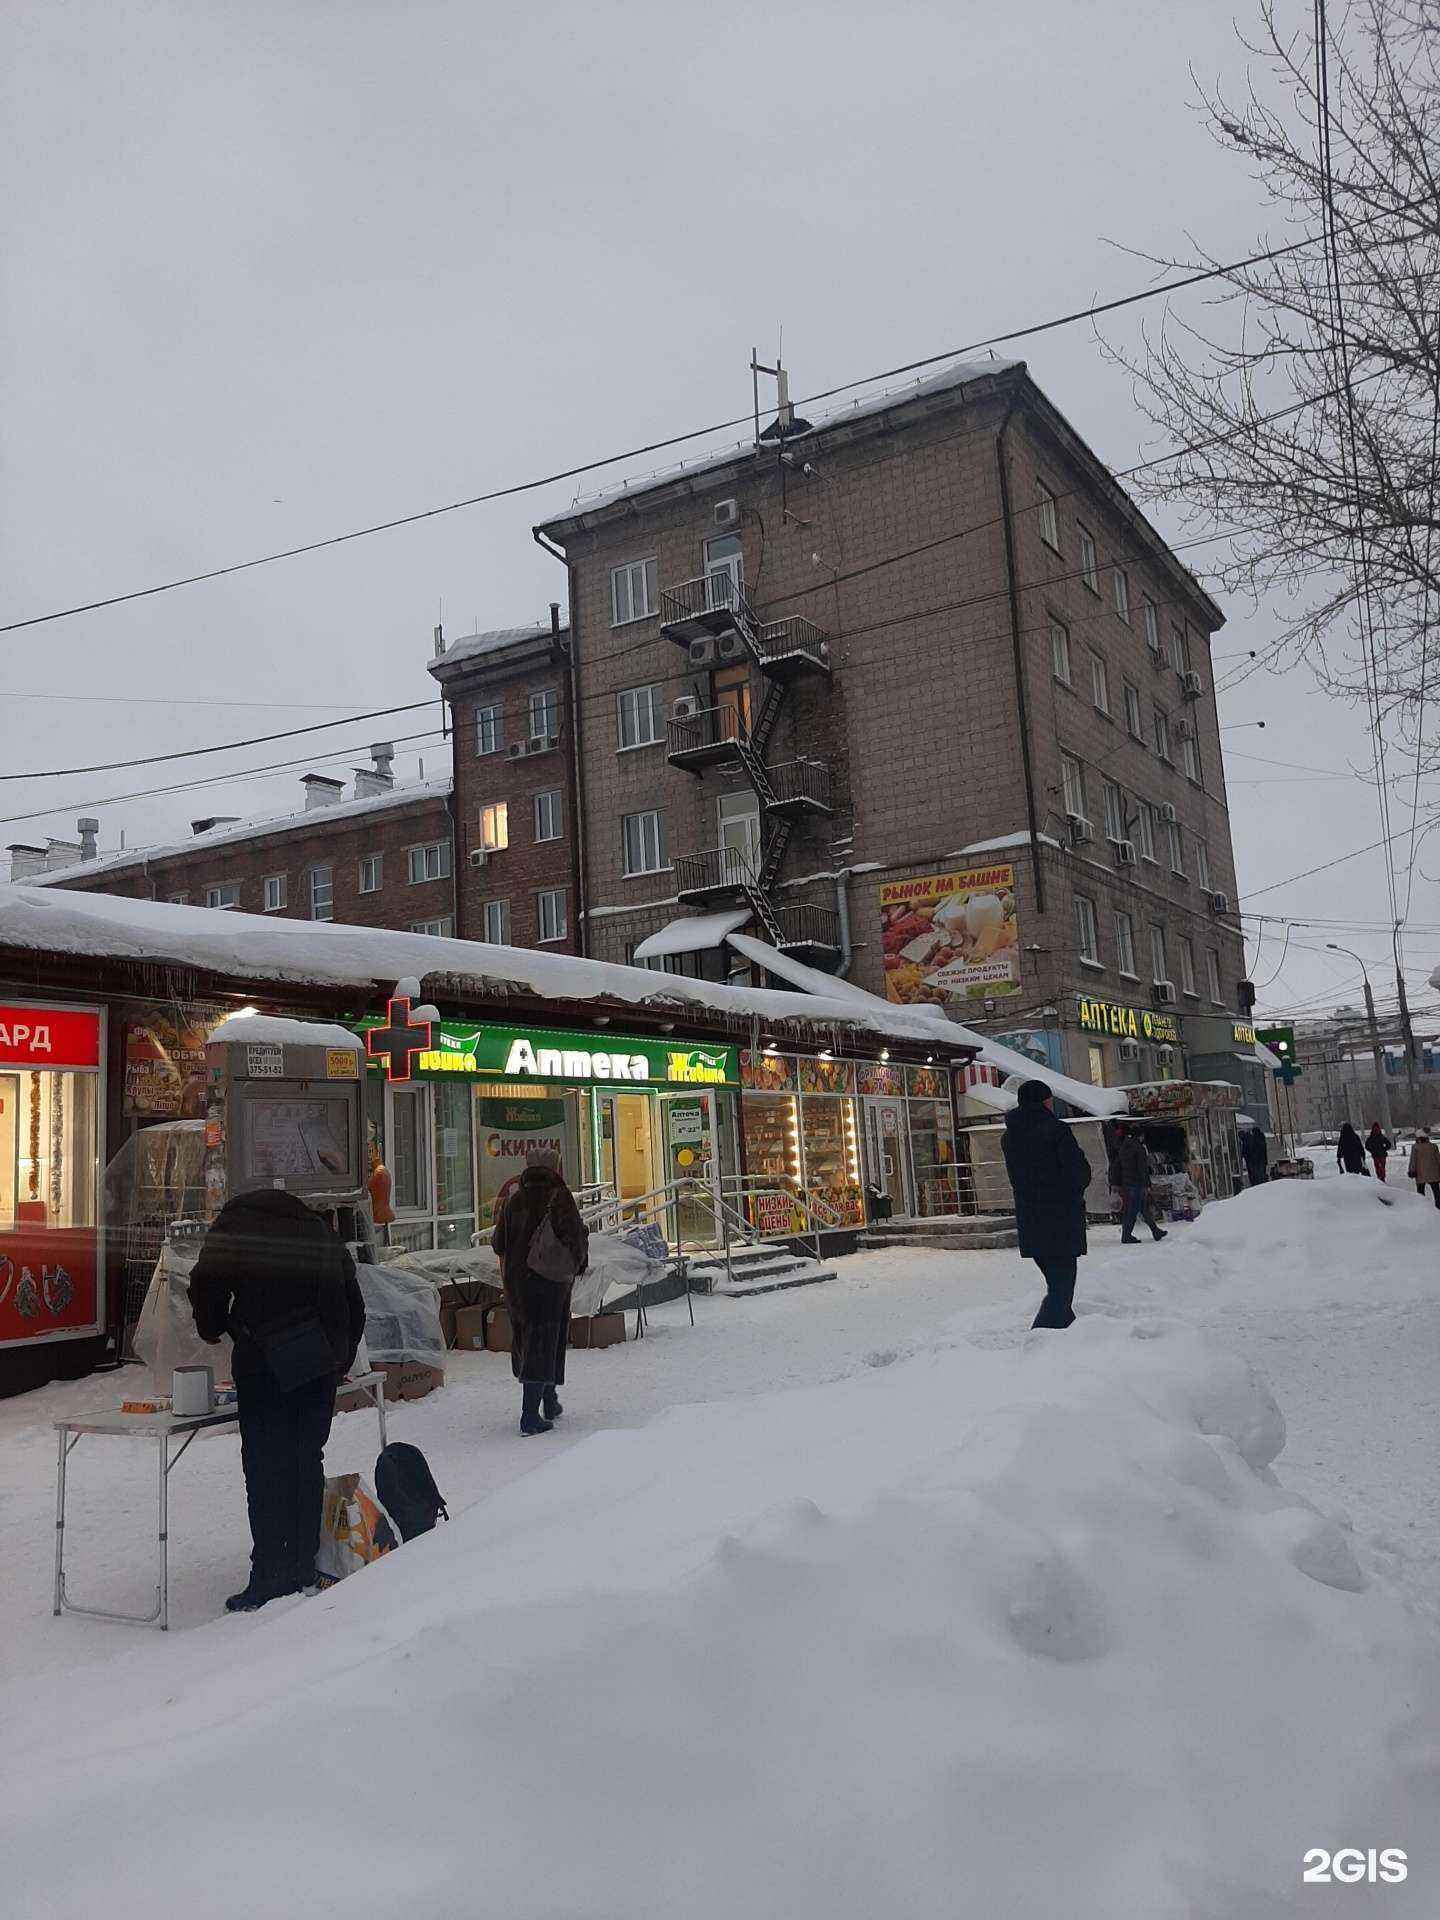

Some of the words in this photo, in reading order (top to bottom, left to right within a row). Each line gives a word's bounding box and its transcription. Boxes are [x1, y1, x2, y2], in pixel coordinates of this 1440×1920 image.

[882, 881, 932, 901] РЫНОК
[935, 877, 954, 893] НА
[958, 868, 1011, 889] БАШНЕ
[951, 975, 980, 984] НИЗКИМ
[983, 972, 1009, 981] ЦЕНАМ
[967, 963, 1009, 974] ПРОДУКТЫ
[1080, 1001, 1138, 1038] АПТЕКА
[504, 1038, 650, 1081] Аптека
